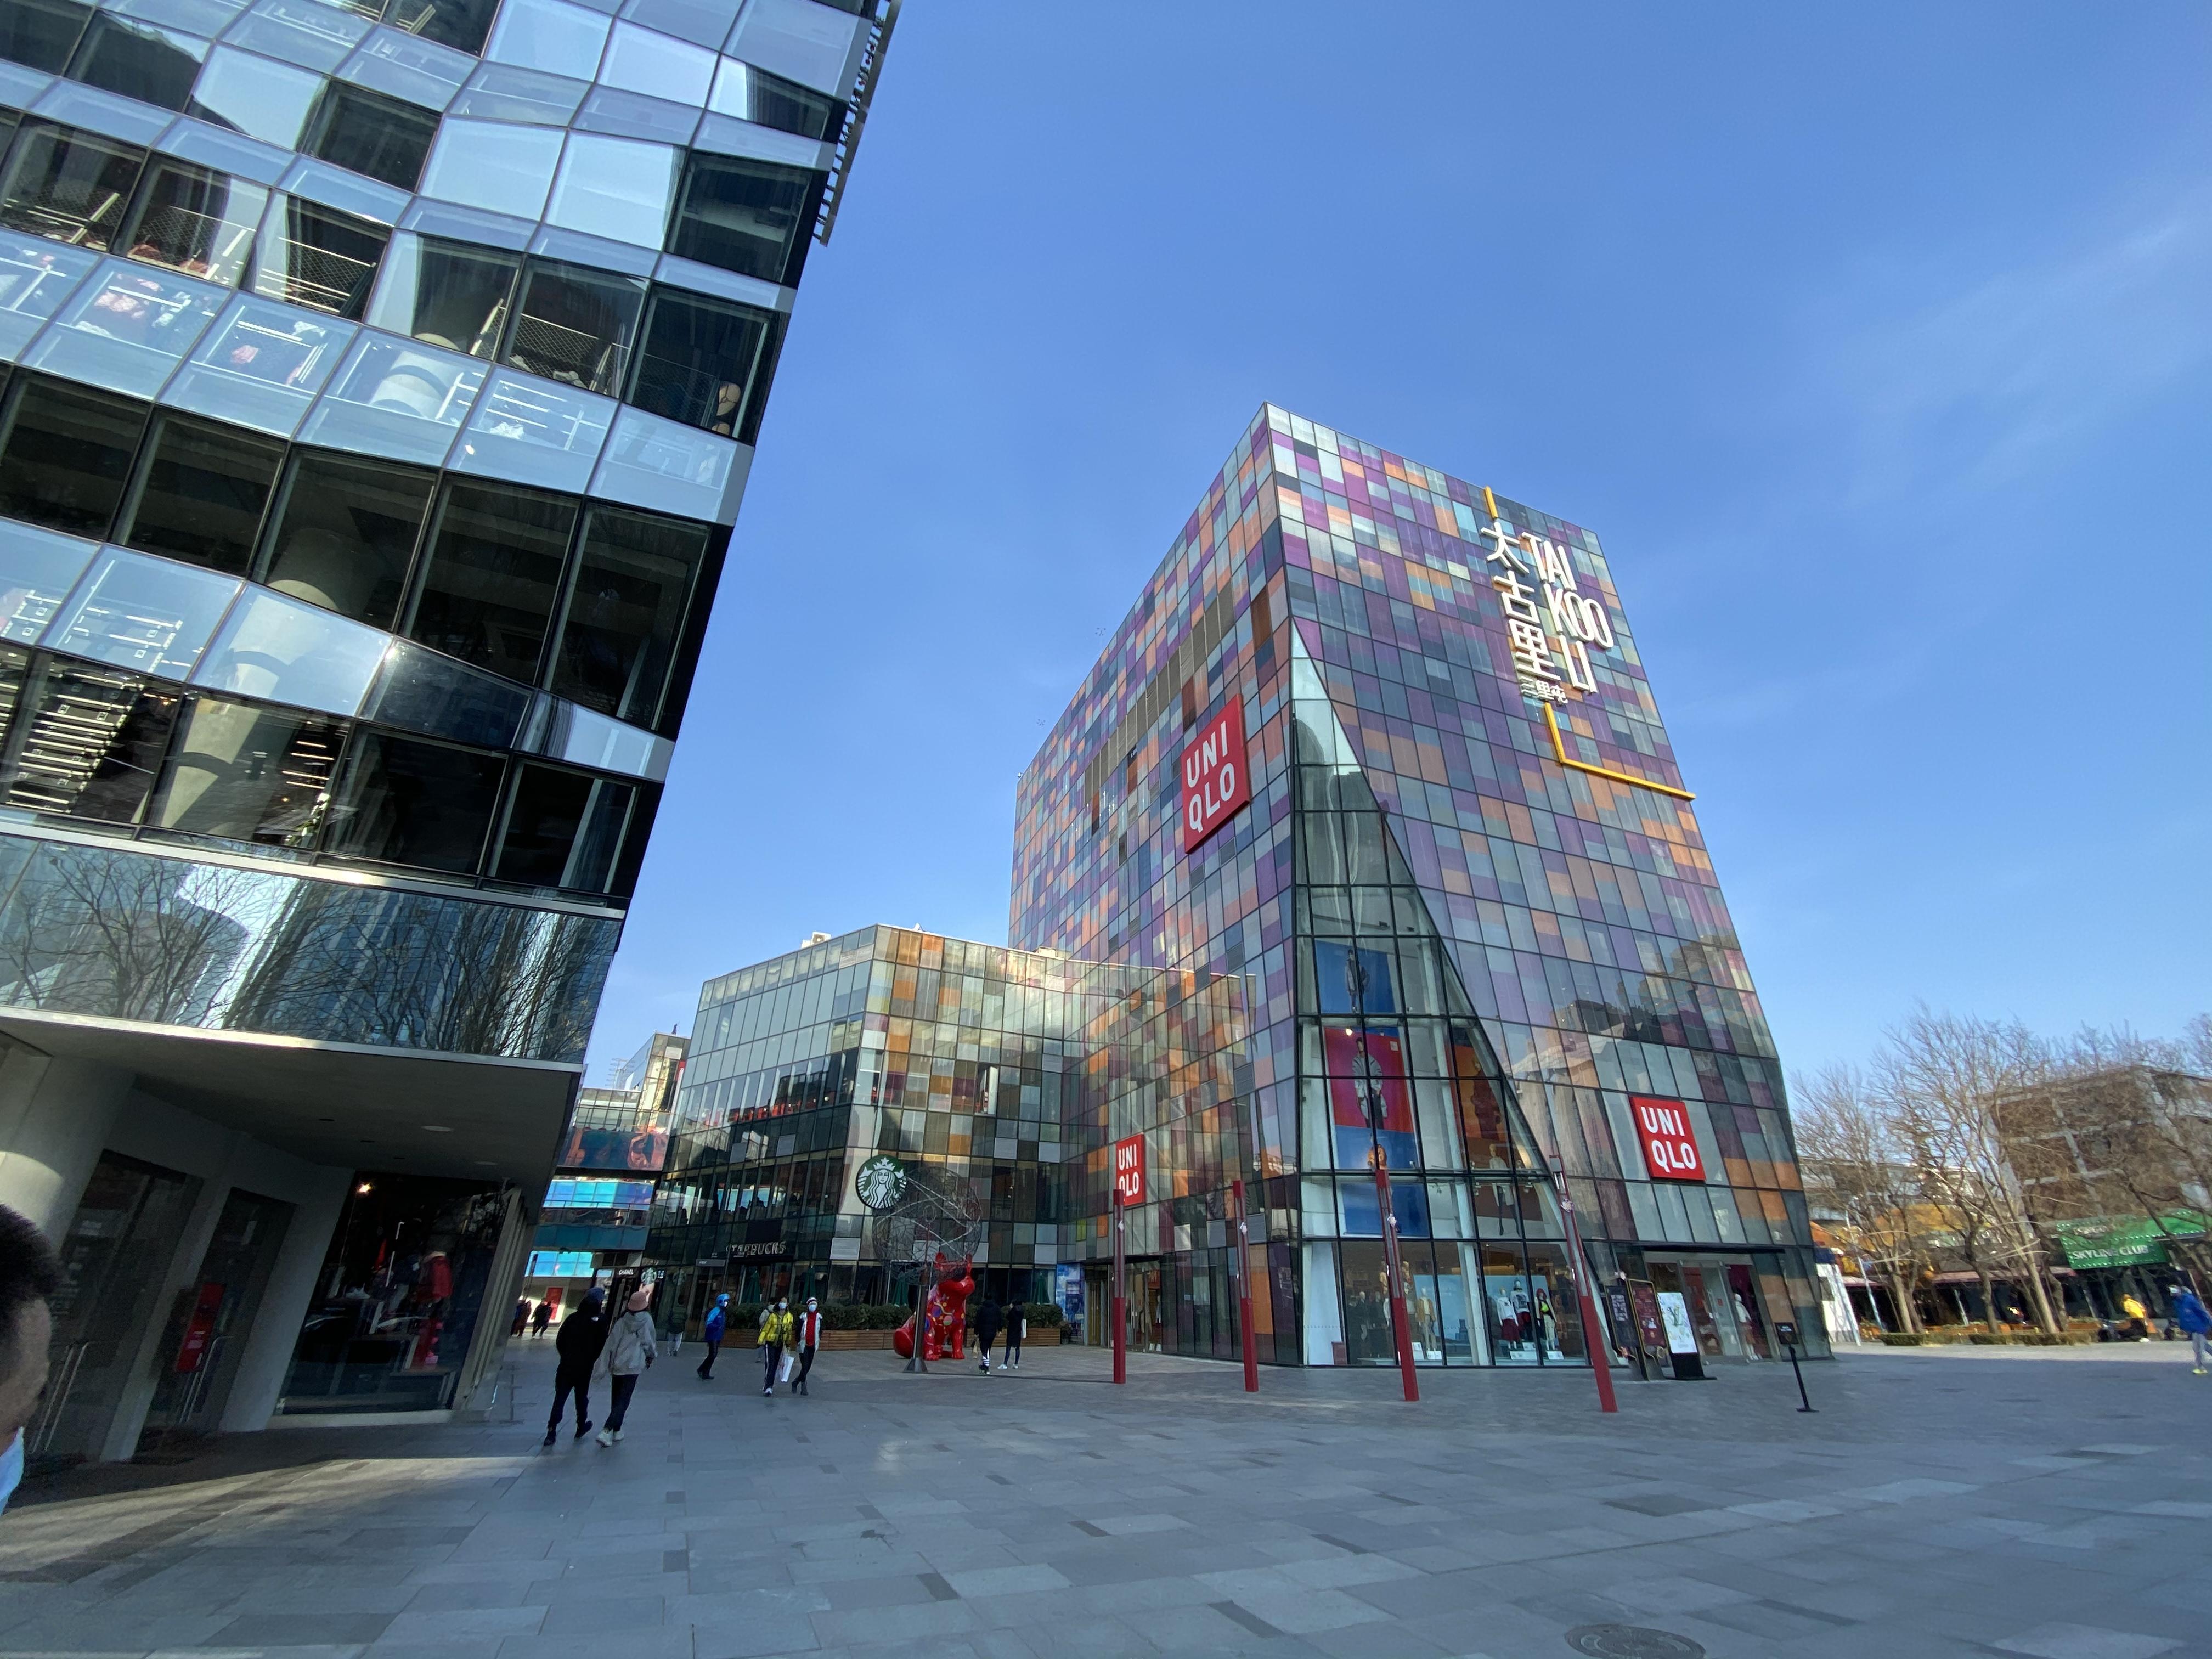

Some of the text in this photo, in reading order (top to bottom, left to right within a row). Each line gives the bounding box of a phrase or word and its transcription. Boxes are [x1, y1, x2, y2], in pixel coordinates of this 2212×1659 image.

[1521, 531, 1577, 591] TAI
[1481, 522, 1561, 681] 太古里
[1544, 583, 1614, 650] KOO
[1519, 676, 1568, 704] 三里屯
[1559, 634, 1598, 694] LI
[1187, 720, 1228, 788] UNI
[1189, 763, 1235, 833] QLO
[1640, 1106, 1685, 1136] UNI
[1118, 1144, 1137, 1171] UNI
[1651, 1139, 1696, 1173] QLO
[2119, 1245, 2149, 1256] CLUB
